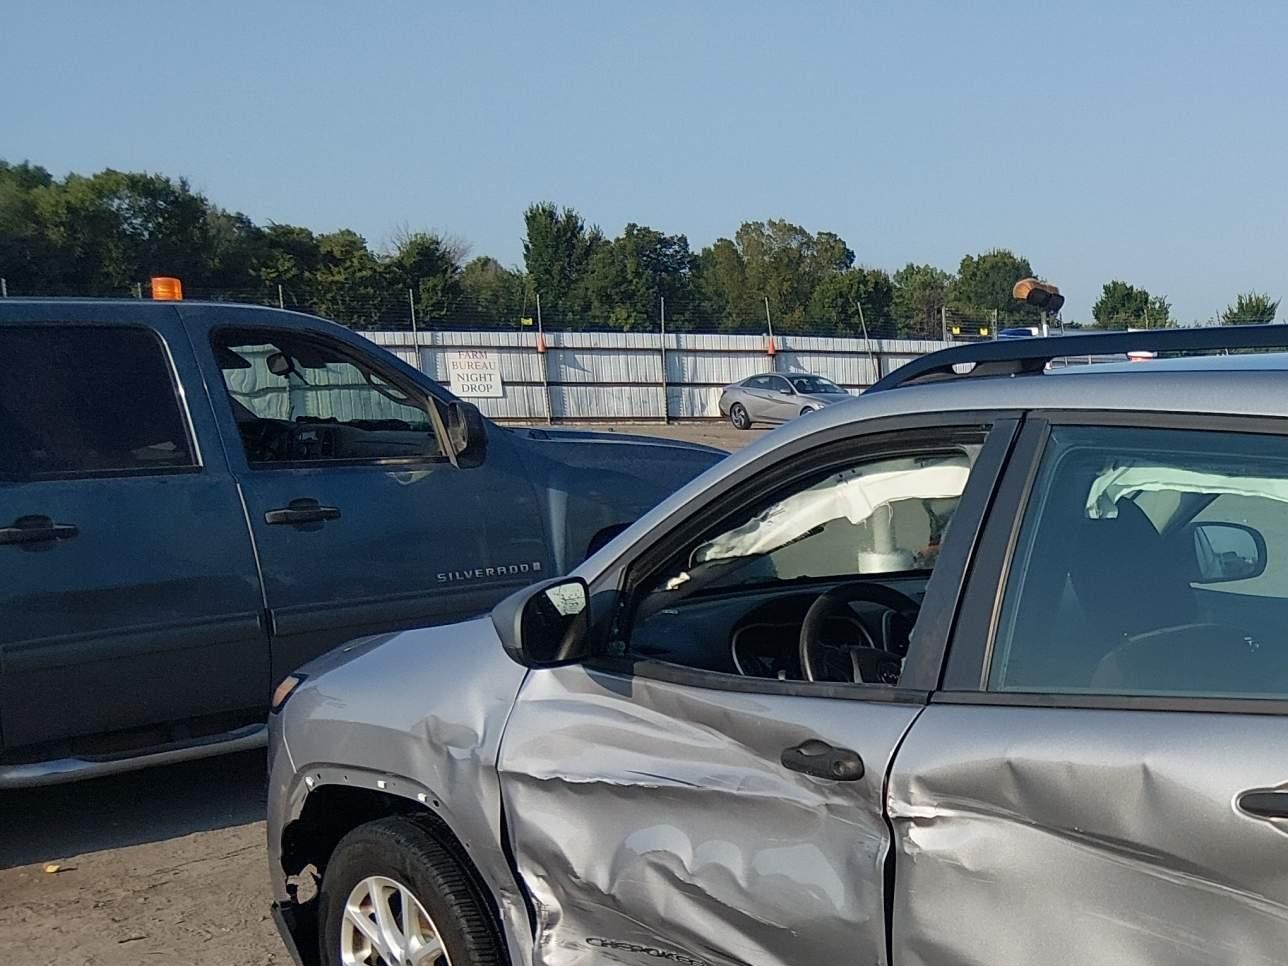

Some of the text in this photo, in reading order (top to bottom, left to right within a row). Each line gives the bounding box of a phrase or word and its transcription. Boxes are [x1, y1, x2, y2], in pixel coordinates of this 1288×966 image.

[457, 351, 488, 360] FARM
[451, 361, 497, 371] BUREAU
[457, 373, 496, 383] NIGHT
[461, 383, 493, 393] DROP
[437, 563, 530, 583] SILVERADO
